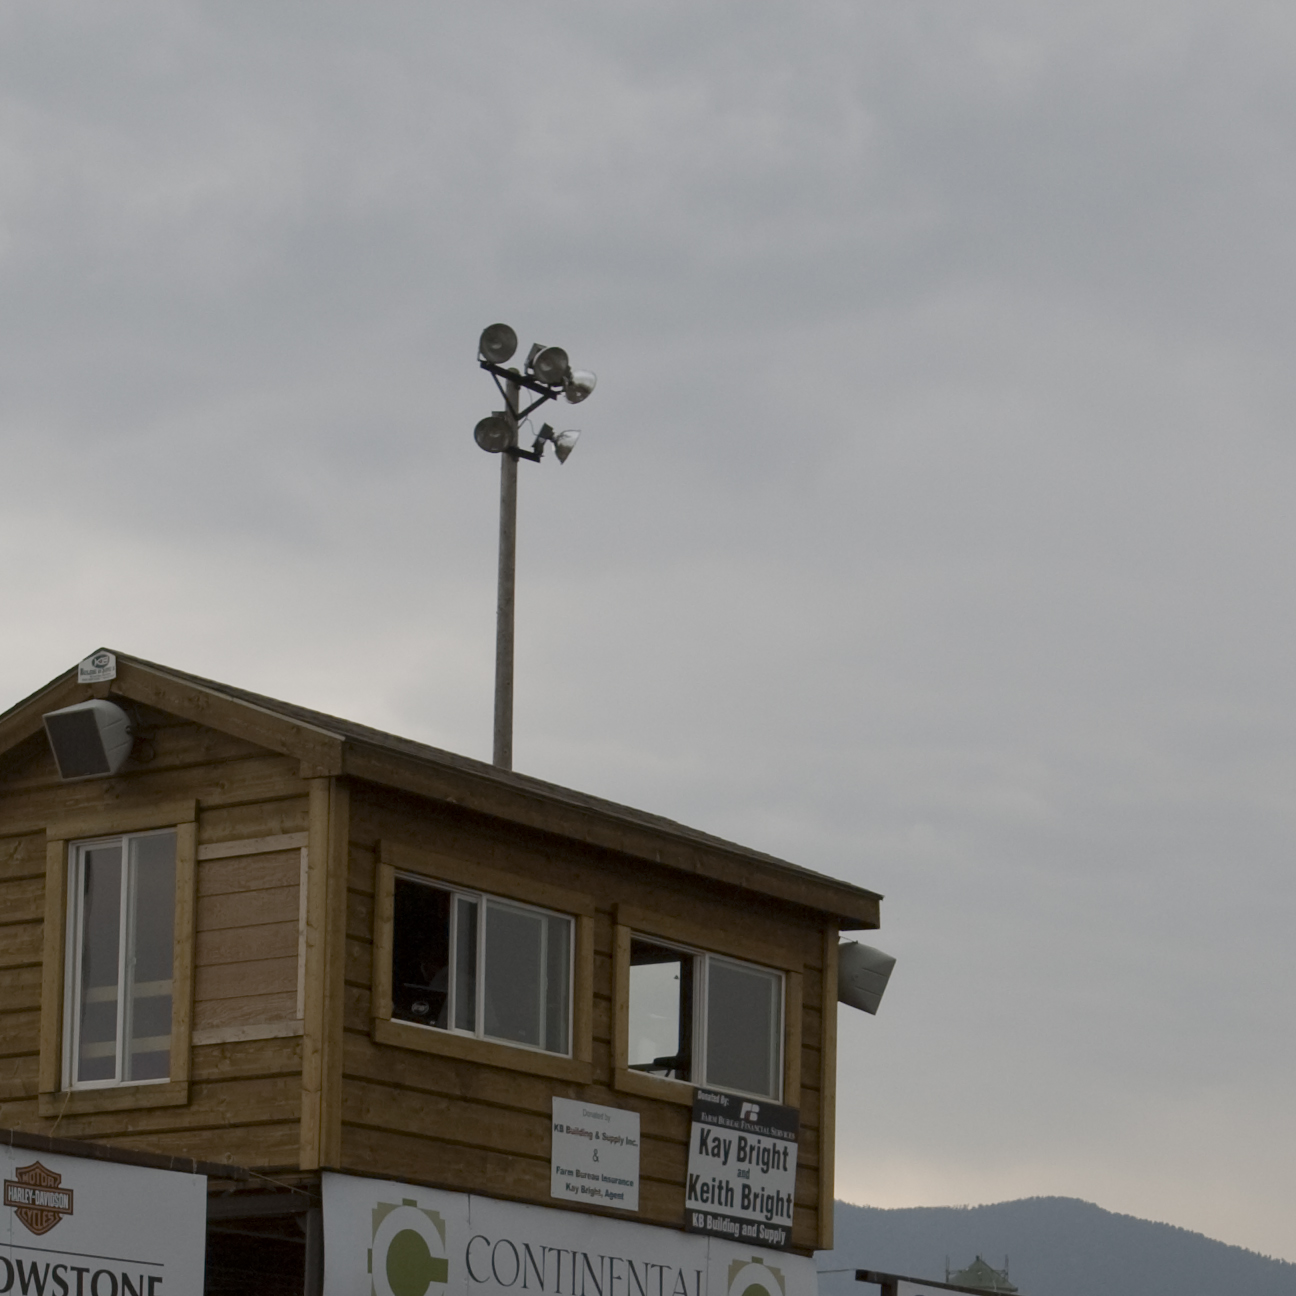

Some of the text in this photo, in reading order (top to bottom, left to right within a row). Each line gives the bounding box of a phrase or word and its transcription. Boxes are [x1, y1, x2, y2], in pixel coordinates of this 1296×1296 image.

[554, 1123, 564, 1133] KB
[592, 1149, 599, 1162] &
[699, 1128, 789, 1174] Kay Bright
[556, 1166, 574, 1177] Farm
[737, 1168, 750, 1180] and
[565, 1183, 579, 1194] Kay
[7, 1186, 69, 1209] HARLEY-DAVIDSON
[688, 1173, 792, 1221] Keith Bright
[692, 1212, 786, 1246] KB Building and Supply
